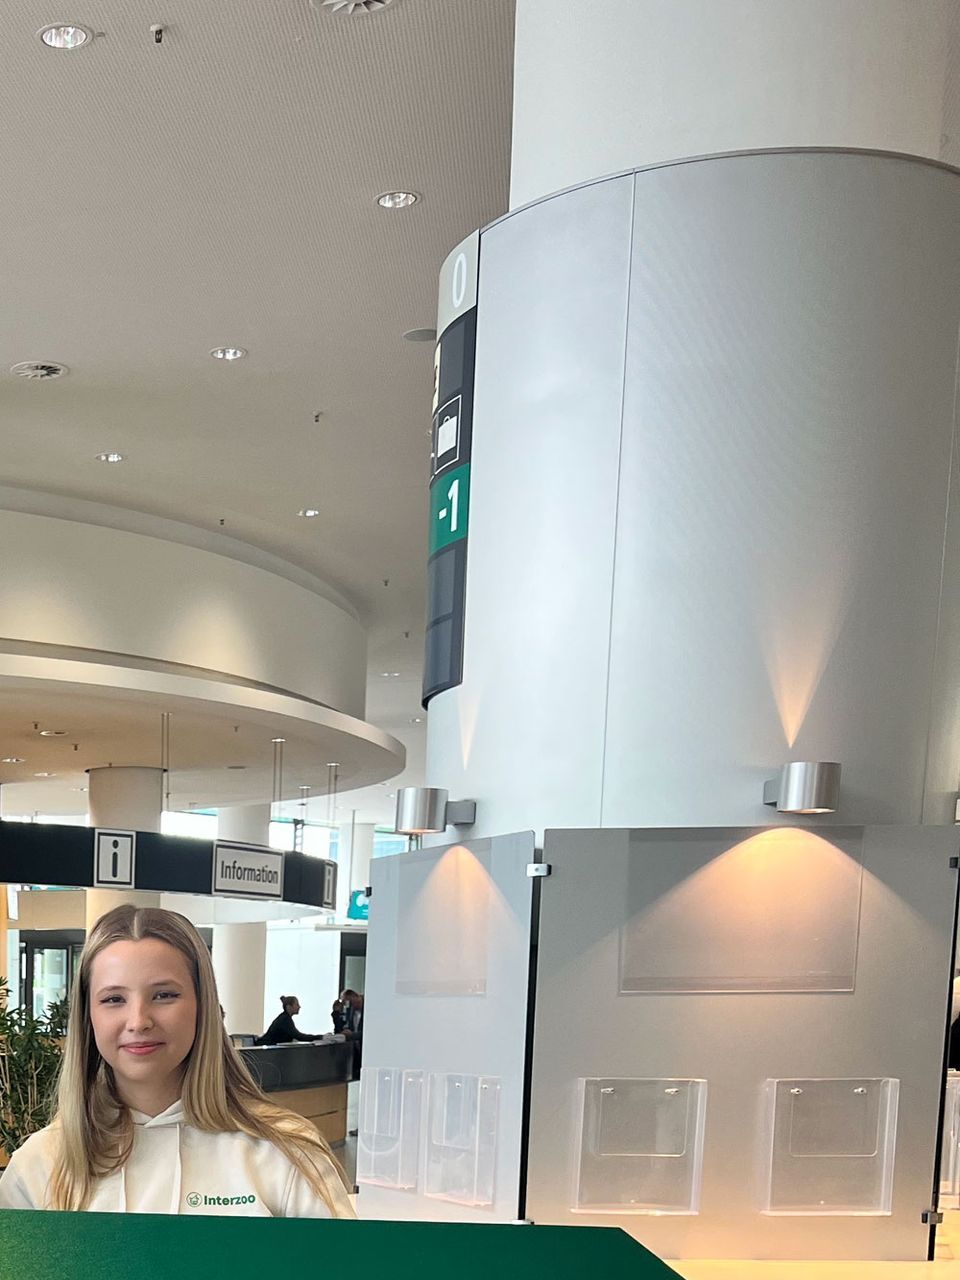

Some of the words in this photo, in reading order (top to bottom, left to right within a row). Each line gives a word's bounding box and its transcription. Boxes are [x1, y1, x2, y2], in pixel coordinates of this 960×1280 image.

[452, 252, 467, 308] 0
[439, 479, 459, 532] -1
[221, 859, 279, 885] Information
[204, 1194, 256, 1206] Interzoo
